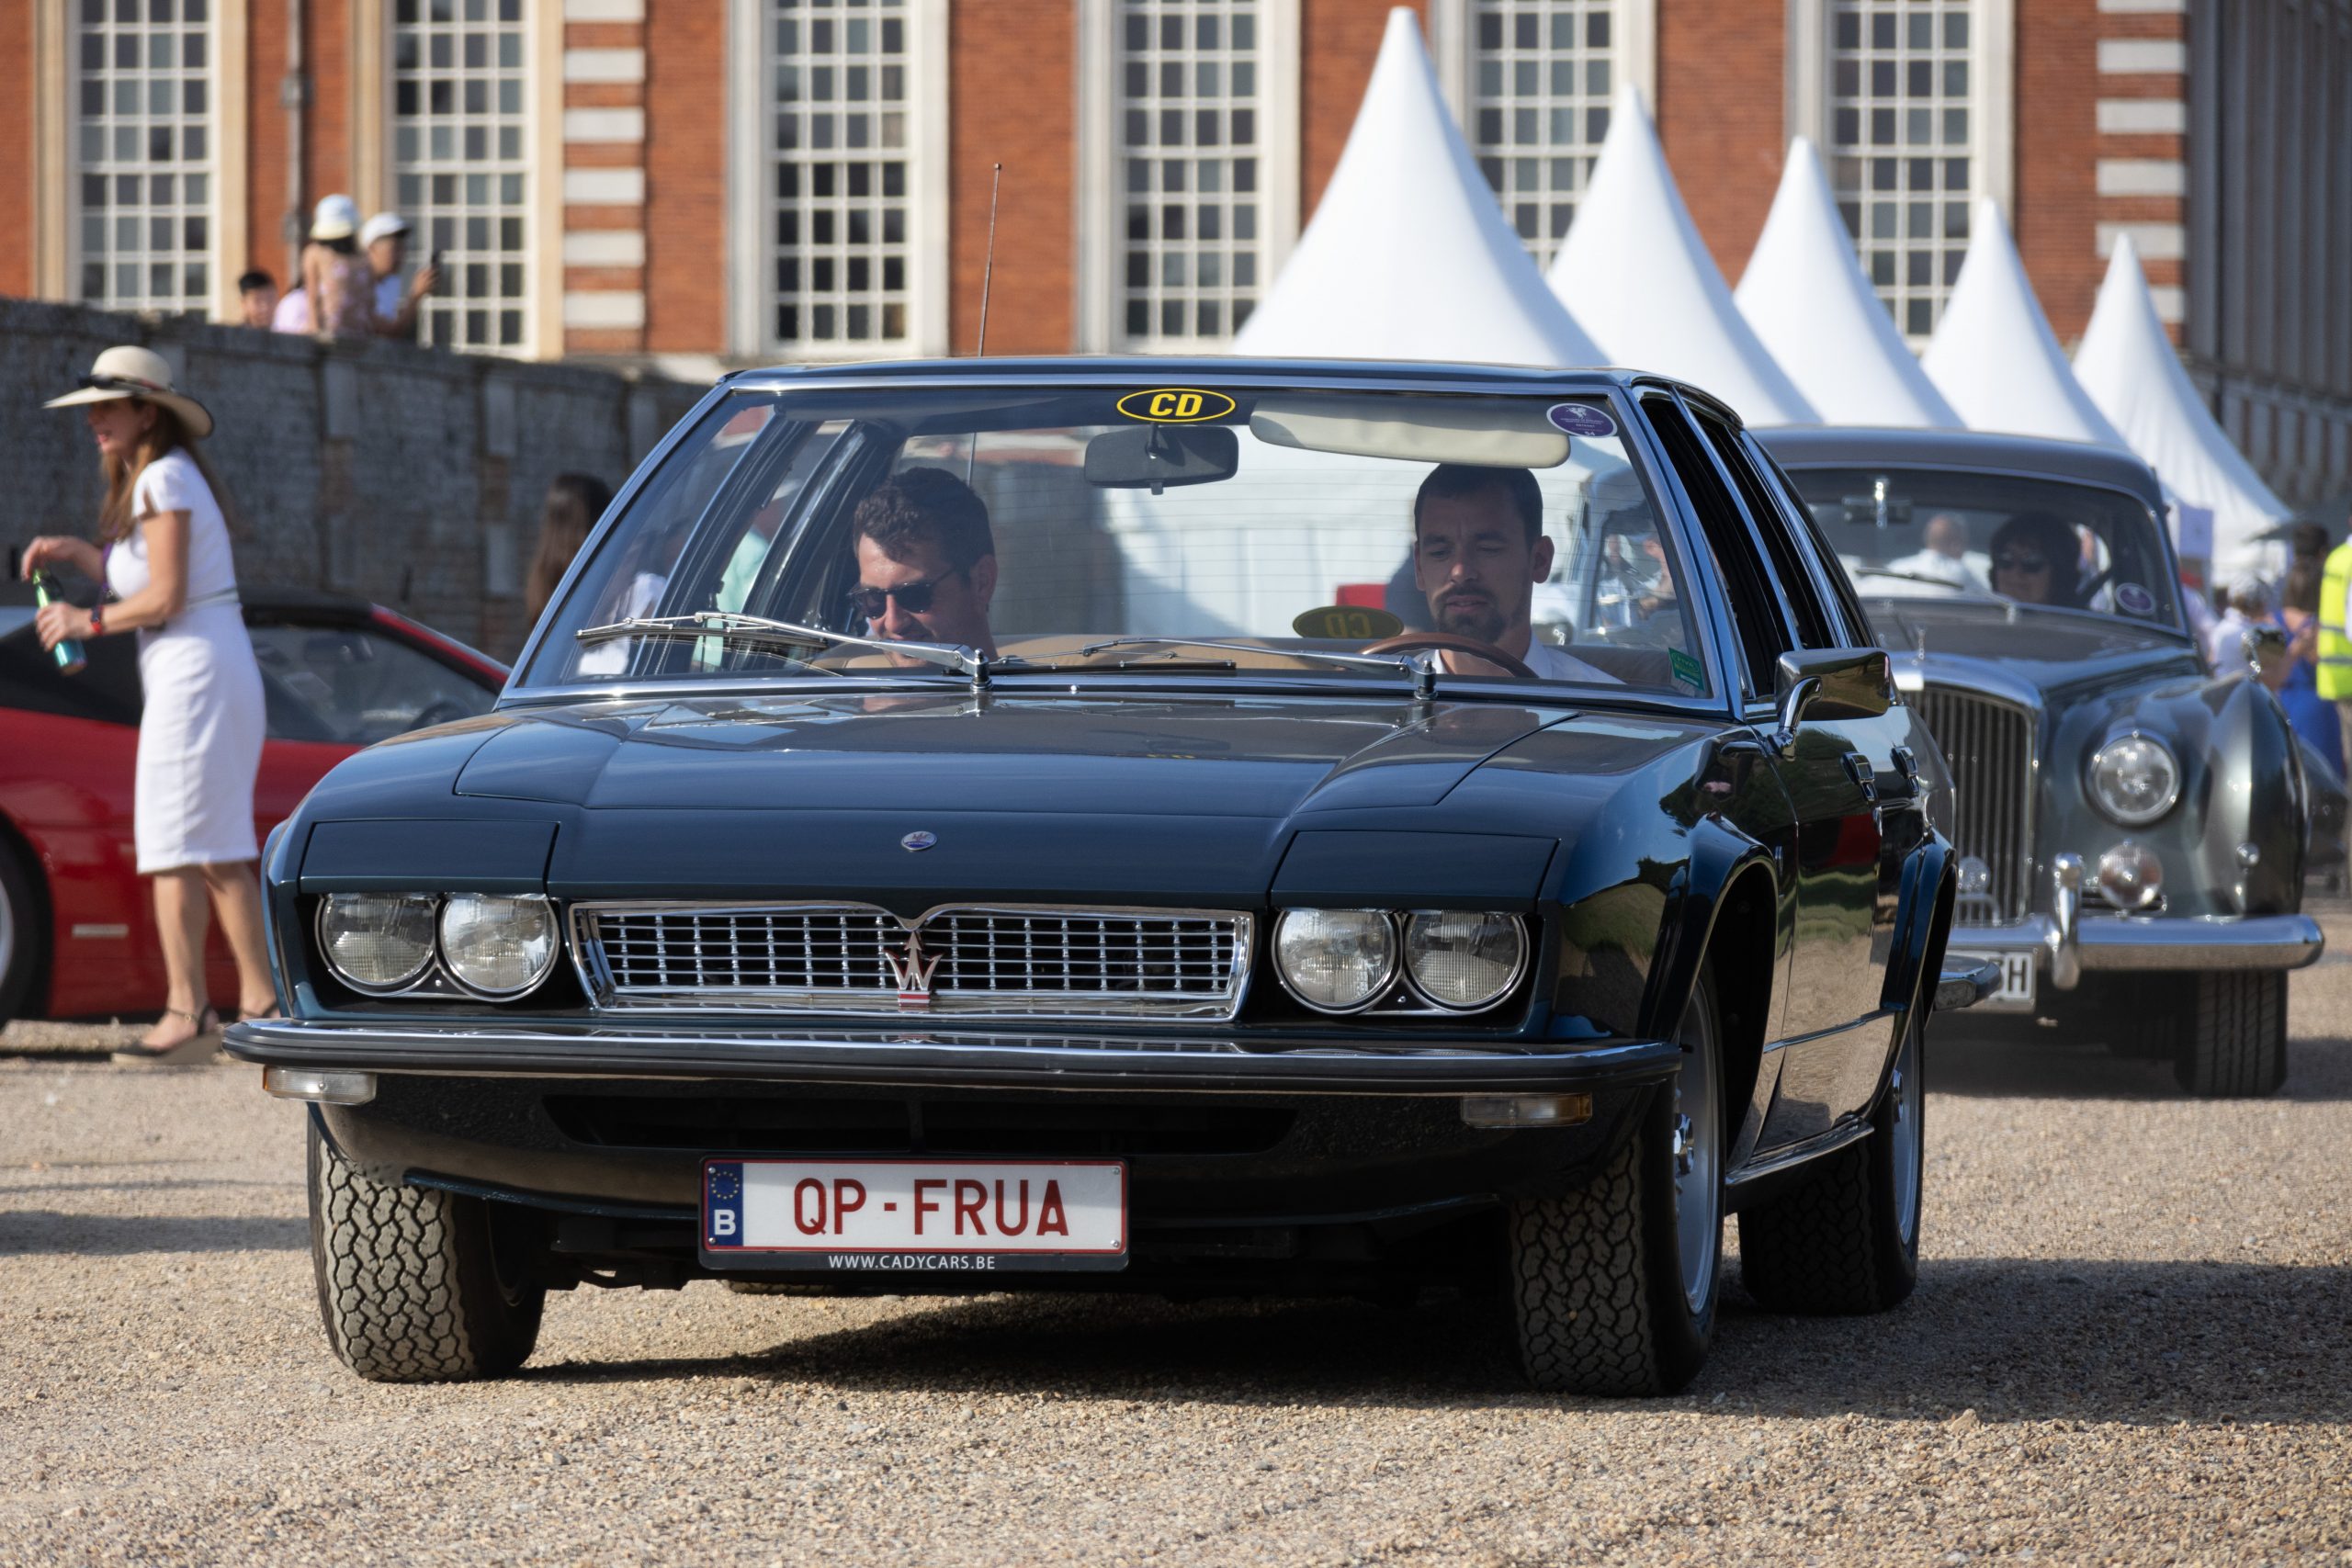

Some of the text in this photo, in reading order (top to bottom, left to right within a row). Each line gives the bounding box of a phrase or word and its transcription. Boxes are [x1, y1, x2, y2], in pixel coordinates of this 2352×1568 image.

[1149, 393, 1203, 417] CD
[714, 1209, 736, 1235] B
[828, 1255, 995, 1269] WWW.CADYCARS.BE
